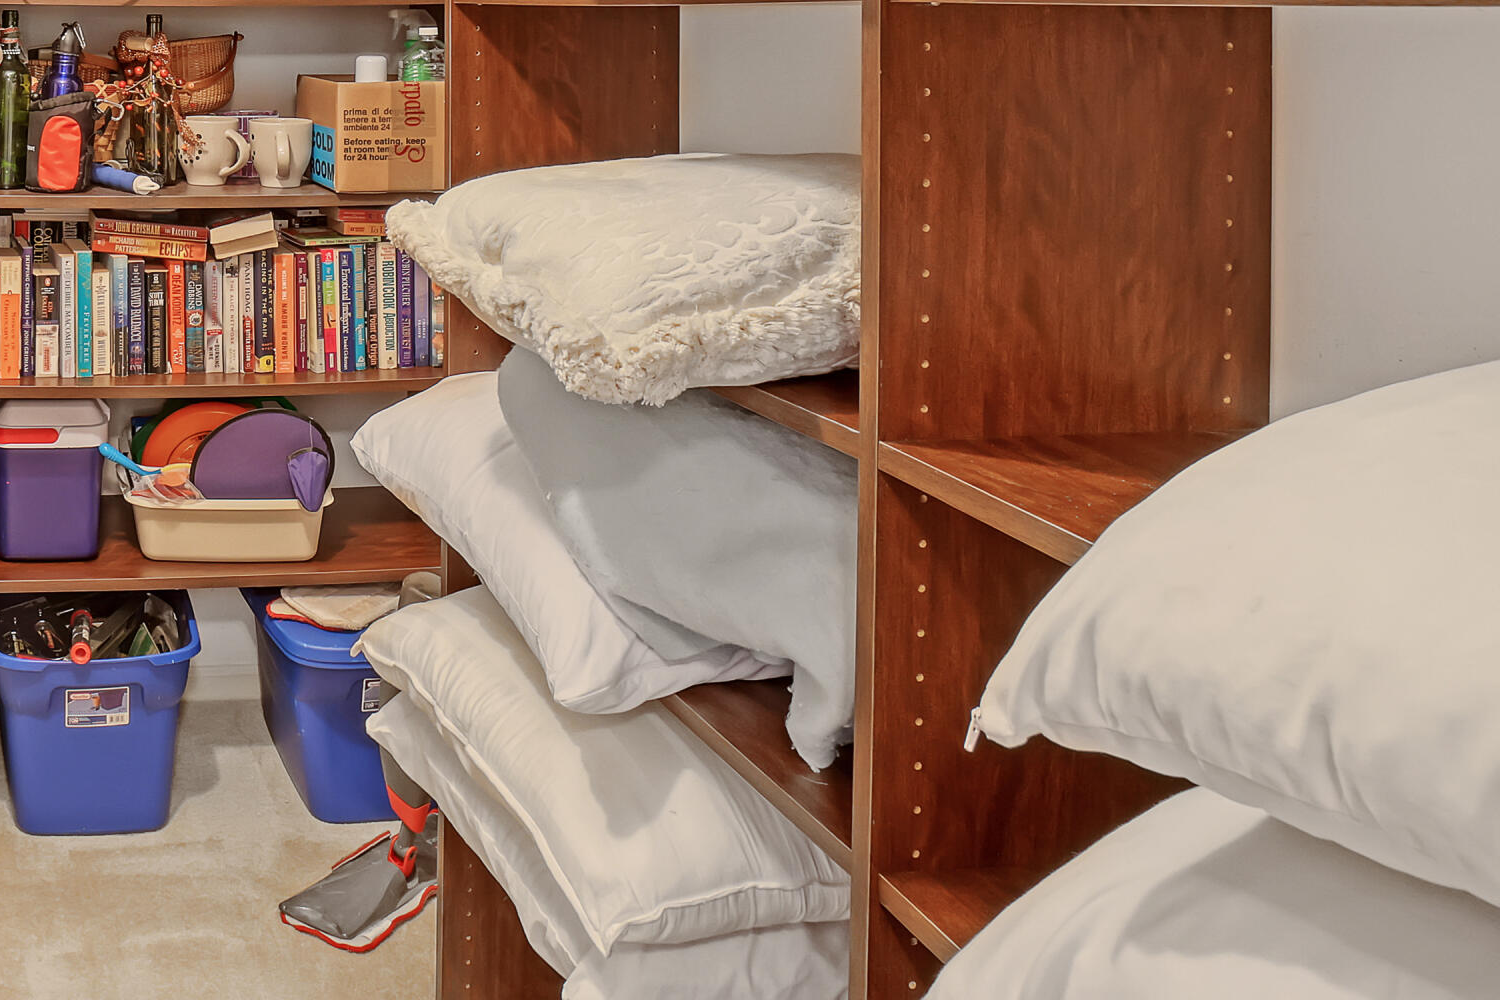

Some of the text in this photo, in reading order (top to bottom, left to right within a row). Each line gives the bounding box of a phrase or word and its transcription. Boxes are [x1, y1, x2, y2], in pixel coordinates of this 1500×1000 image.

[344, 108, 367, 116] prima
[115, 222, 130, 232] JOHN
[132, 223, 160, 234] GRISHAM
[34, 228, 43, 263] COULTE
[109, 236, 134, 244] RICHARD
[160, 242, 195, 257] ECLIPSE
[367, 247, 375, 275] PATRICIA
[382, 261, 394, 286] ROBIN
[261, 286, 267, 294] IN
[342, 269, 351, 301] Emotional
[368, 276, 376, 310] CORNWELL
[402, 277, 410, 306] PILCHER
[131, 287, 142, 308] DAVID
[172, 275, 181, 325] DEAN KOONTZ
[383, 287, 394, 309] COOK
[268, 307, 273, 318] OF
[340, 302, 351, 333] Intelligence
[369, 314, 377, 332] Point
[131, 309, 142, 341] BALDACCI
[369, 343, 377, 365] Origin
